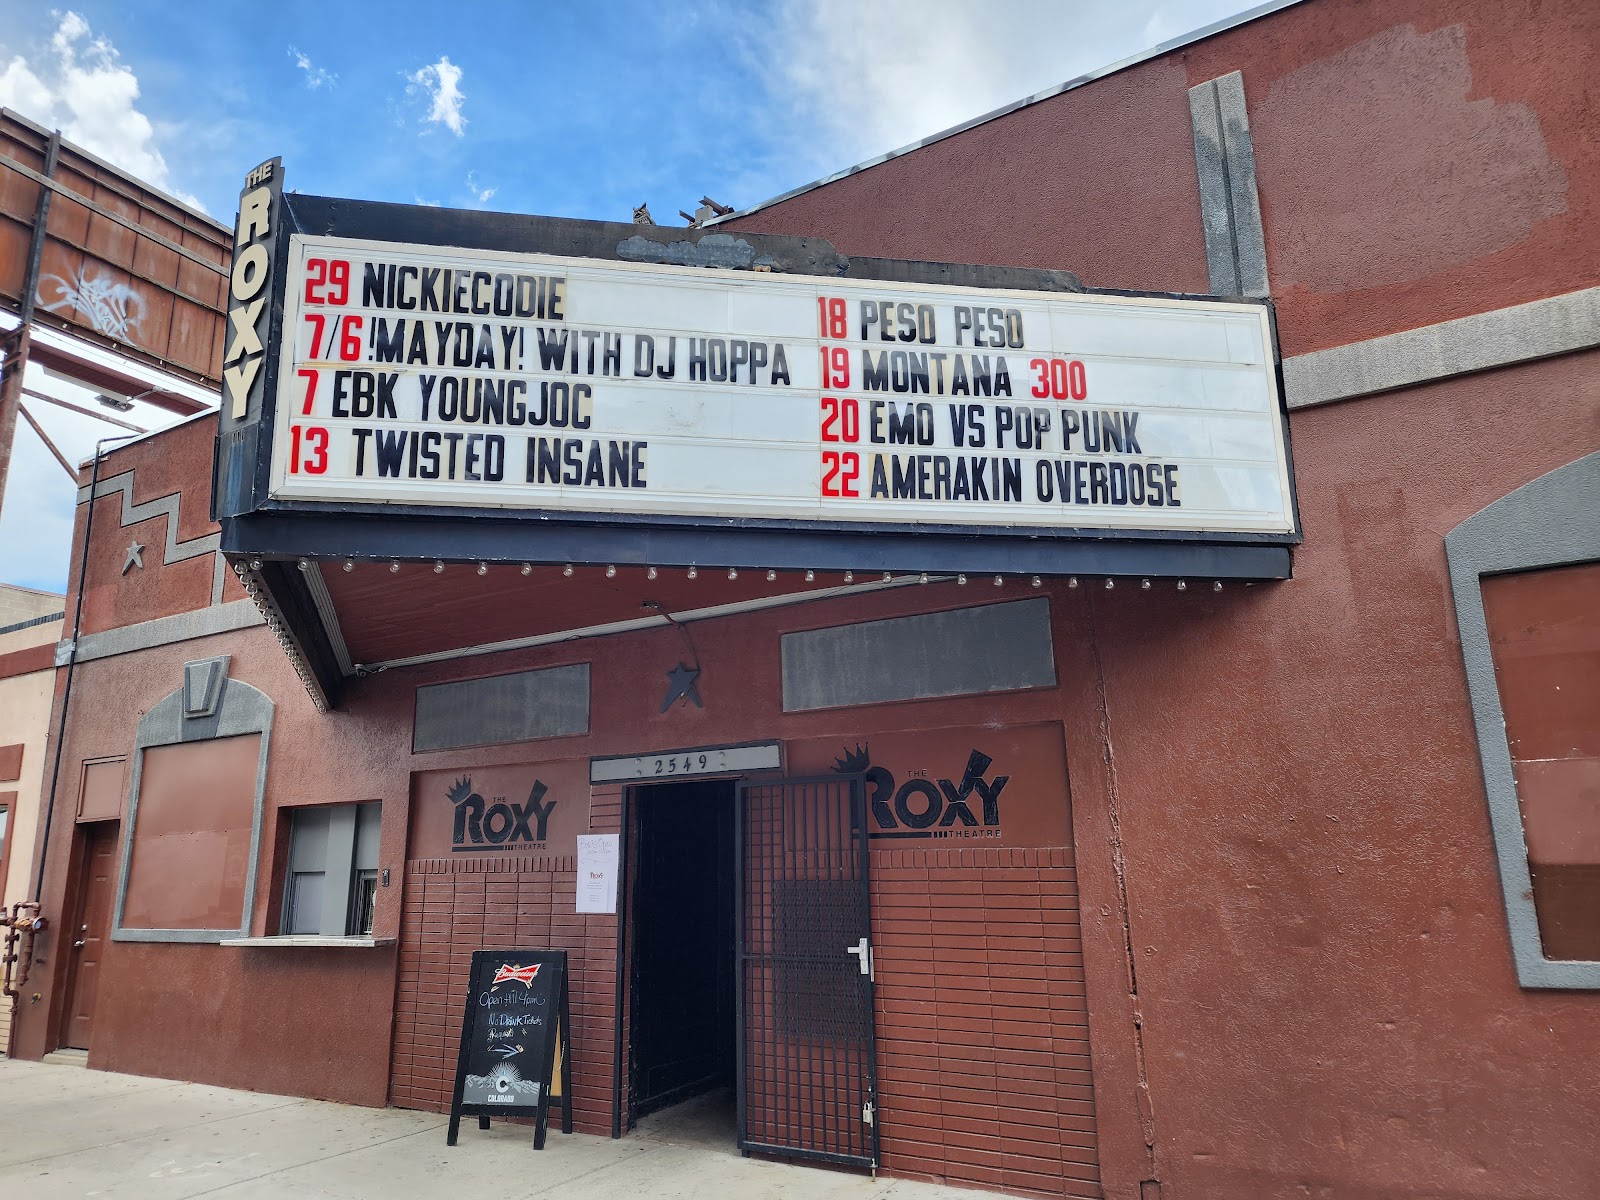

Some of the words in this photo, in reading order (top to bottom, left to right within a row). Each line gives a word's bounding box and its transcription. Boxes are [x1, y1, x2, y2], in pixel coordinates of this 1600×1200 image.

[246, 161, 273, 189] THE
[223, 186, 272, 419] ROXY
[304, 258, 349, 306] 29
[363, 262, 566, 320] NICKIECODIE
[818, 296, 848, 340] 18
[860, 300, 936, 345] PESO
[955, 305, 1024, 349] PESO
[305, 314, 362, 361] 7/6
[368, 316, 523, 371] !MAYDAY!
[537, 329, 620, 377] WITH
[634, 334, 675, 380] DJ
[689, 338, 791, 386] HOPPA
[820, 346, 850, 389] 19
[862, 349, 1012, 397] MONTANA
[1030, 358, 1087, 400] 300
[297, 369, 318, 415] 7
[332, 371, 399, 419] EBK
[419, 374, 592, 430] YOUNGJOC
[821, 397, 860, 444] 20
[870, 400, 934, 446] EMO
[949, 403, 986, 448] VS
[995, 405, 1051, 450] POP
[1062, 409, 1142, 455] PUNK
[290, 425, 329, 475] 13
[352, 429, 504, 482] TWISTED
[525, 437, 647, 488] INSANE
[821, 451, 860, 498] 22
[870, 453, 1022, 502] AMERAKIN
[1036, 459, 1181, 507] OVERDOSE
[655, 754, 707, 774] 2549
[907, 769, 927, 778] THE
[453, 779, 558, 844] ROXY
[493, 796, 506, 804] THE
[949, 830, 1002, 838] THEATRE
[479, 991, 503, 1009] Open
[495, 968, 538, 978] Budweiser
